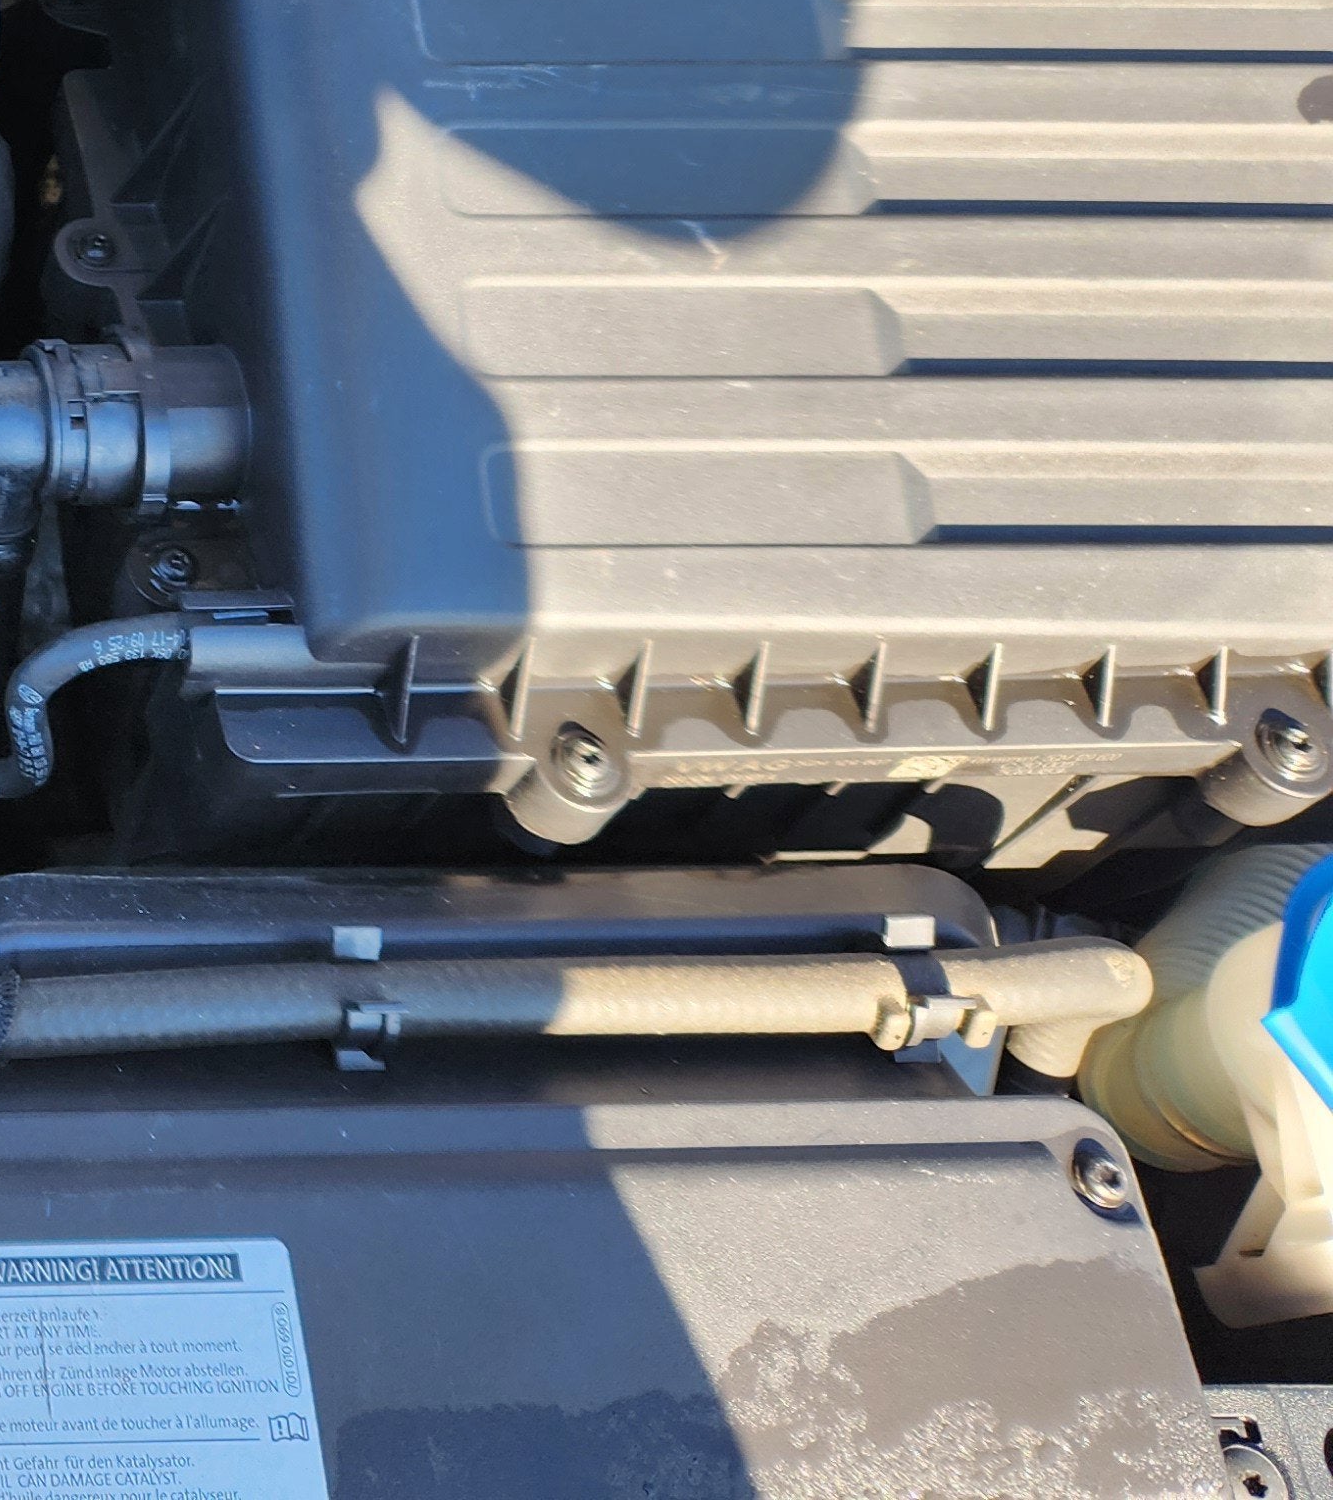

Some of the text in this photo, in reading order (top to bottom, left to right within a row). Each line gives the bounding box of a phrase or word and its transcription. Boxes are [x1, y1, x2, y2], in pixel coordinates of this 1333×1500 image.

[106, 1256, 234, 1282] ATTENTION!
[13, 1324, 29, 1339] AT
[33, 1323, 61, 1339] ANY
[47, 1343, 63, 1356] se
[138, 1339, 148, 1354] à
[149, 1340, 180, 1354] tout
[181, 1338, 243, 1354] moment.
[282, 1346, 294, 1368] 010
[139, 1362, 181, 1379] Motor
[183, 1361, 248, 1378] abstellen.
[4, 1382, 30, 1398] OFF
[32, 1380, 84, 1399] ENGINE
[86, 1379, 137, 1397] BEFORE
[139, 1379, 214, 1396] TOUCHING
[215, 1377, 280, 1394] IGNITION
[8, 1416, 58, 1433] moteur
[61, 1416, 100, 1432] avant
[100, 1415, 119, 1431] de
[119, 1414, 172, 1431] toucher
[175, 1414, 184, 1430] à
[185, 1413, 260, 1433] l'allumage.
[11, 1453, 59, 1471] Gefahr
[63, 1454, 85, 1470] für
[86, 1452, 114, 1470] den
[114, 1452, 195, 1473] Katalysator.
[16, 1471, 47, 1489] CAN
[49, 1470, 112, 1488] DAMAGE
[114, 1469, 182, 1487] CATALYST.
